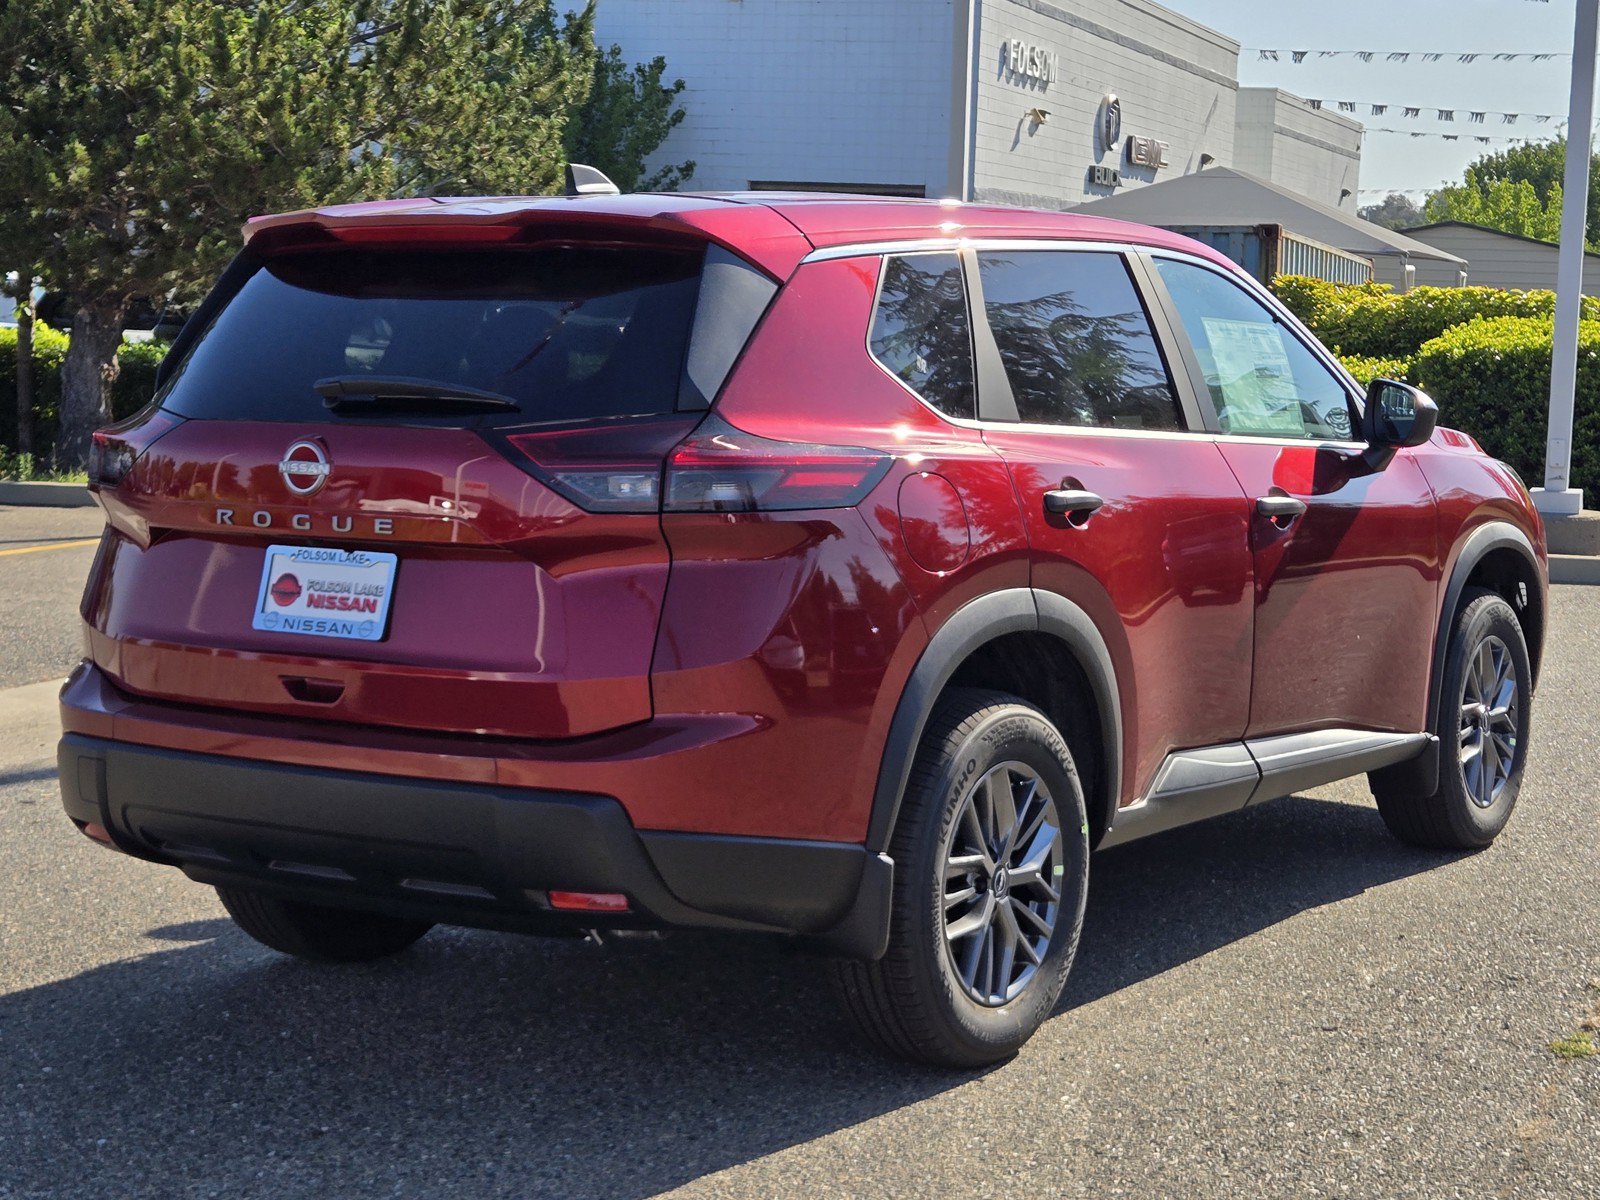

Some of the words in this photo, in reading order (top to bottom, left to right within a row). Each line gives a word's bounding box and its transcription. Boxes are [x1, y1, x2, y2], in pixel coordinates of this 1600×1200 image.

[1009, 38, 1059, 84] FOLSOM
[1131, 135, 1170, 169] GMC
[278, 460, 330, 476] NISSAN
[215, 508, 394, 535] ROGUE
[296, 549, 337, 563] FOLSOM
[338, 552, 366, 565] LAKE
[306, 578, 352, 594] FOLSOM
[353, 581, 384, 597] LAKE
[306, 593, 378, 614] NISSAN
[282, 617, 354, 635] NISSAN
[939, 758, 976, 845] KUMHO
